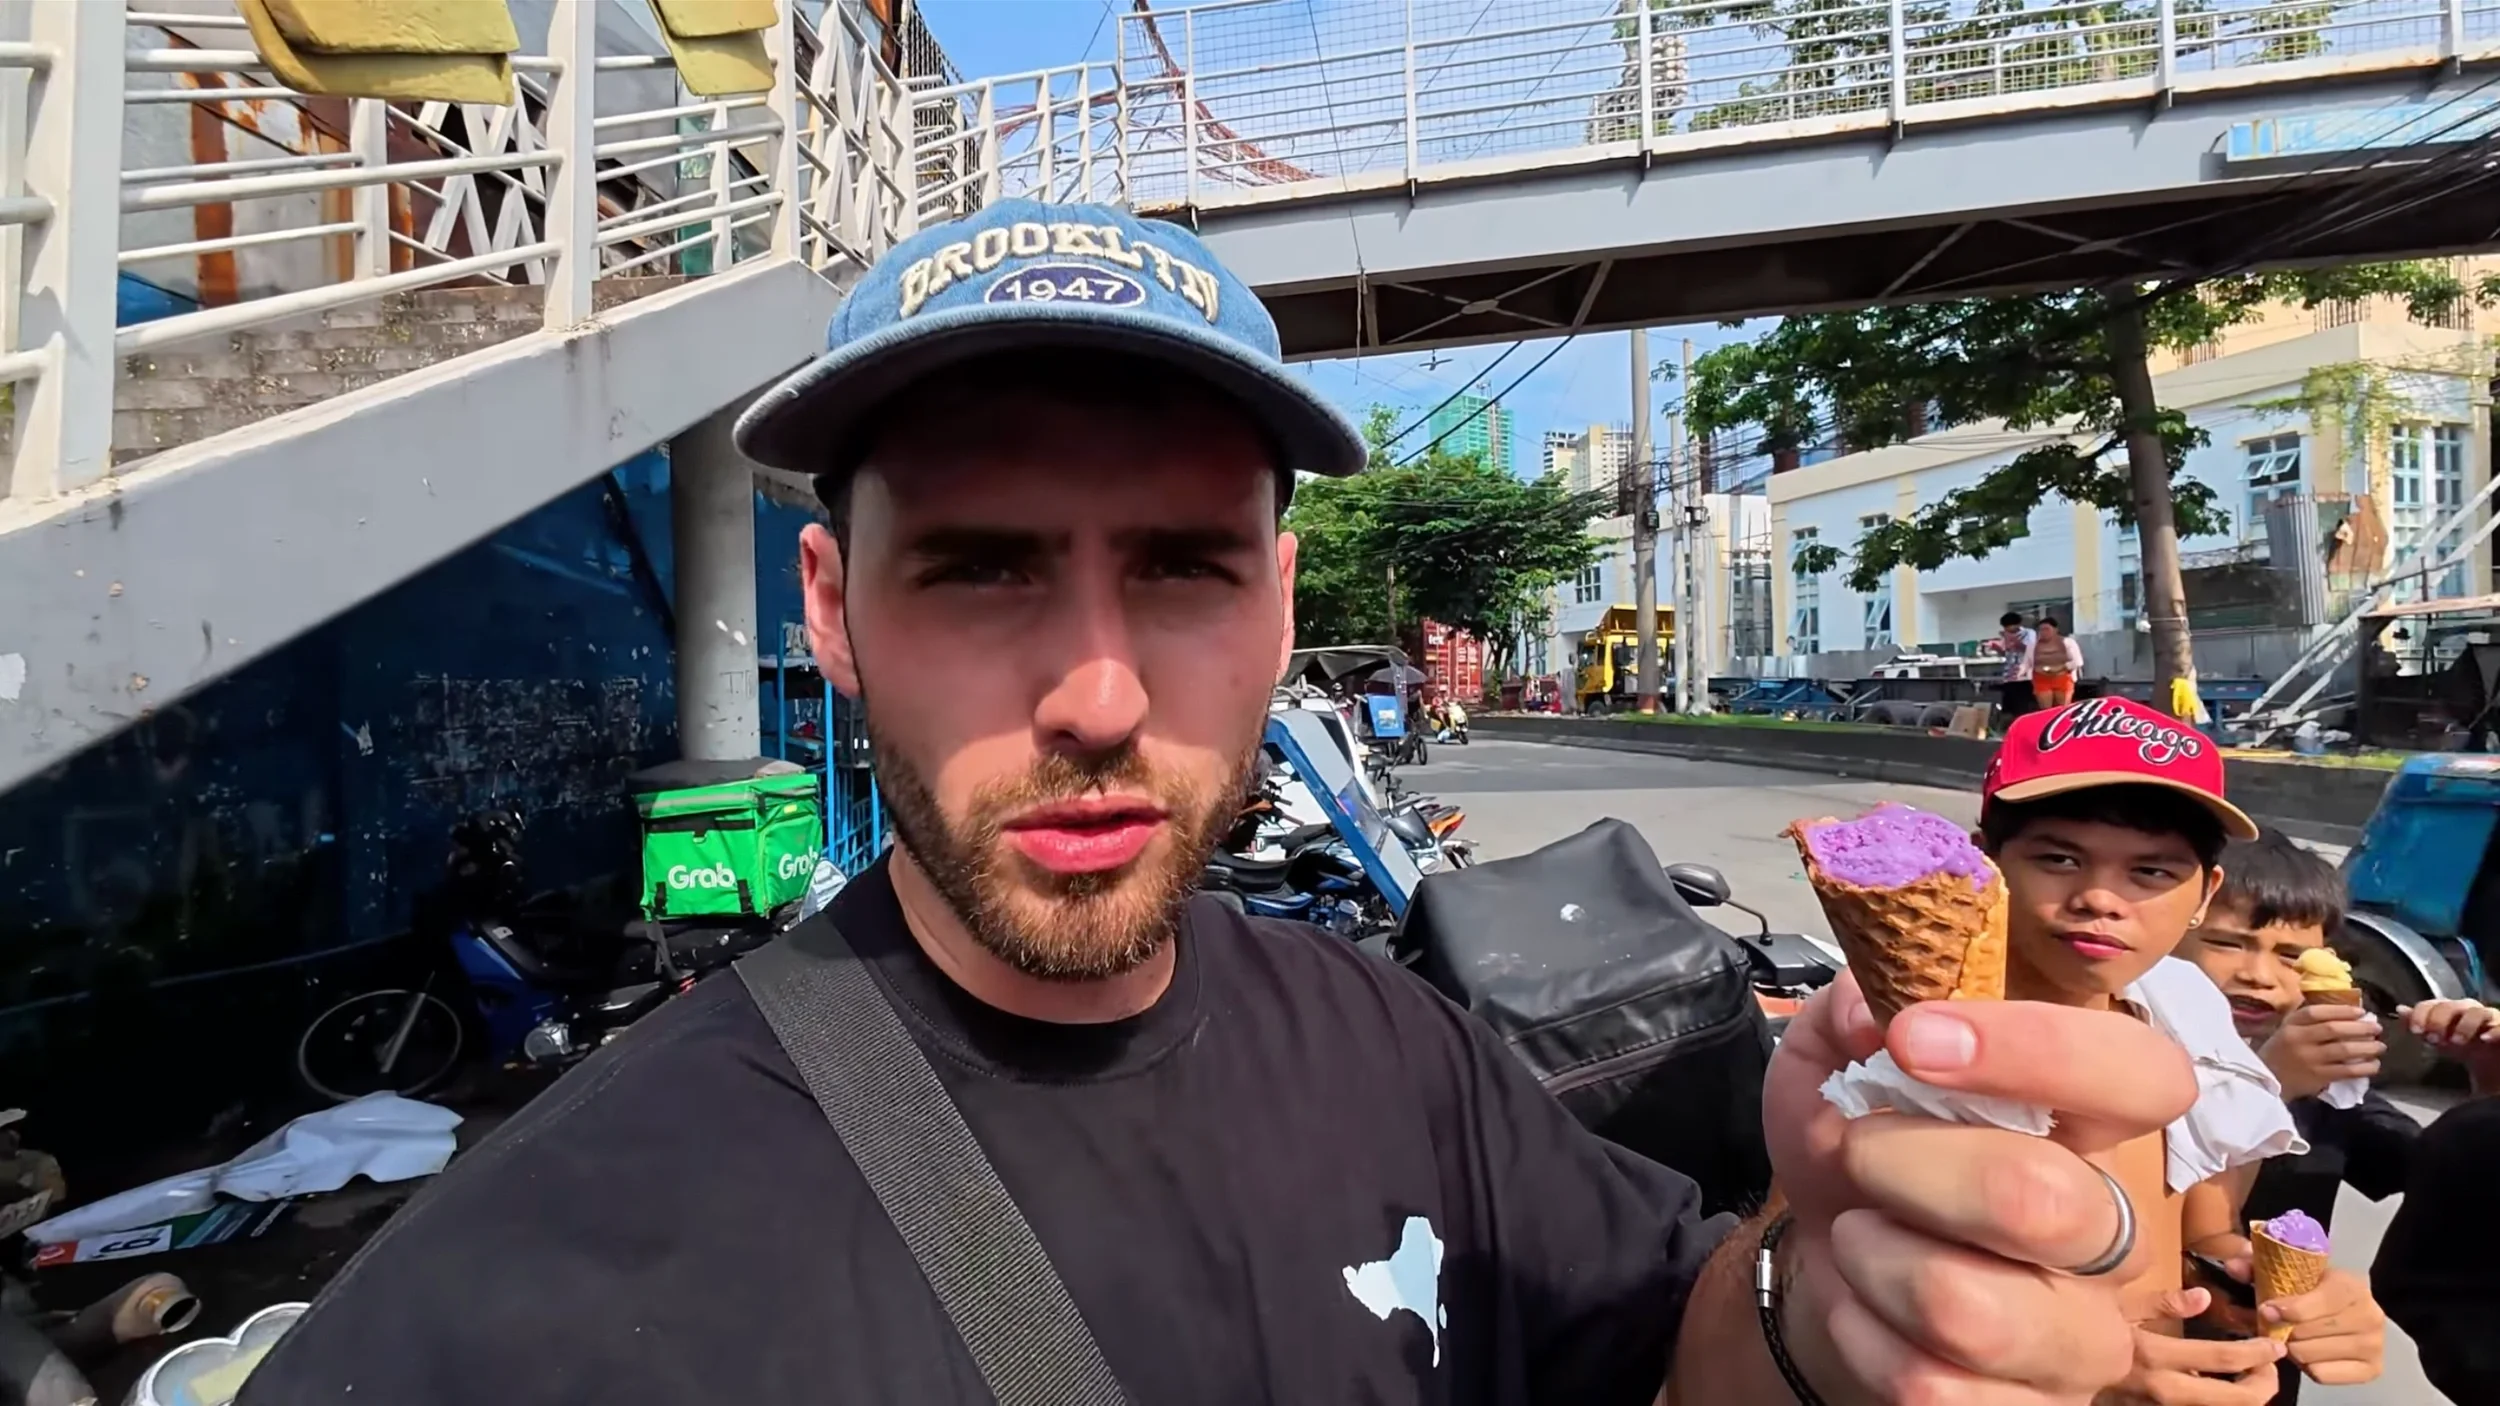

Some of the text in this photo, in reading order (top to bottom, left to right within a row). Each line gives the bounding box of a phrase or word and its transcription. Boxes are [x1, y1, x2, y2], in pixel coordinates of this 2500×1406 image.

[898, 221, 1220, 324] BROOKLYN
[1005, 276, 1125, 303] 1947
[2038, 698, 2202, 765] Chicago
[668, 862, 738, 889] Grab
